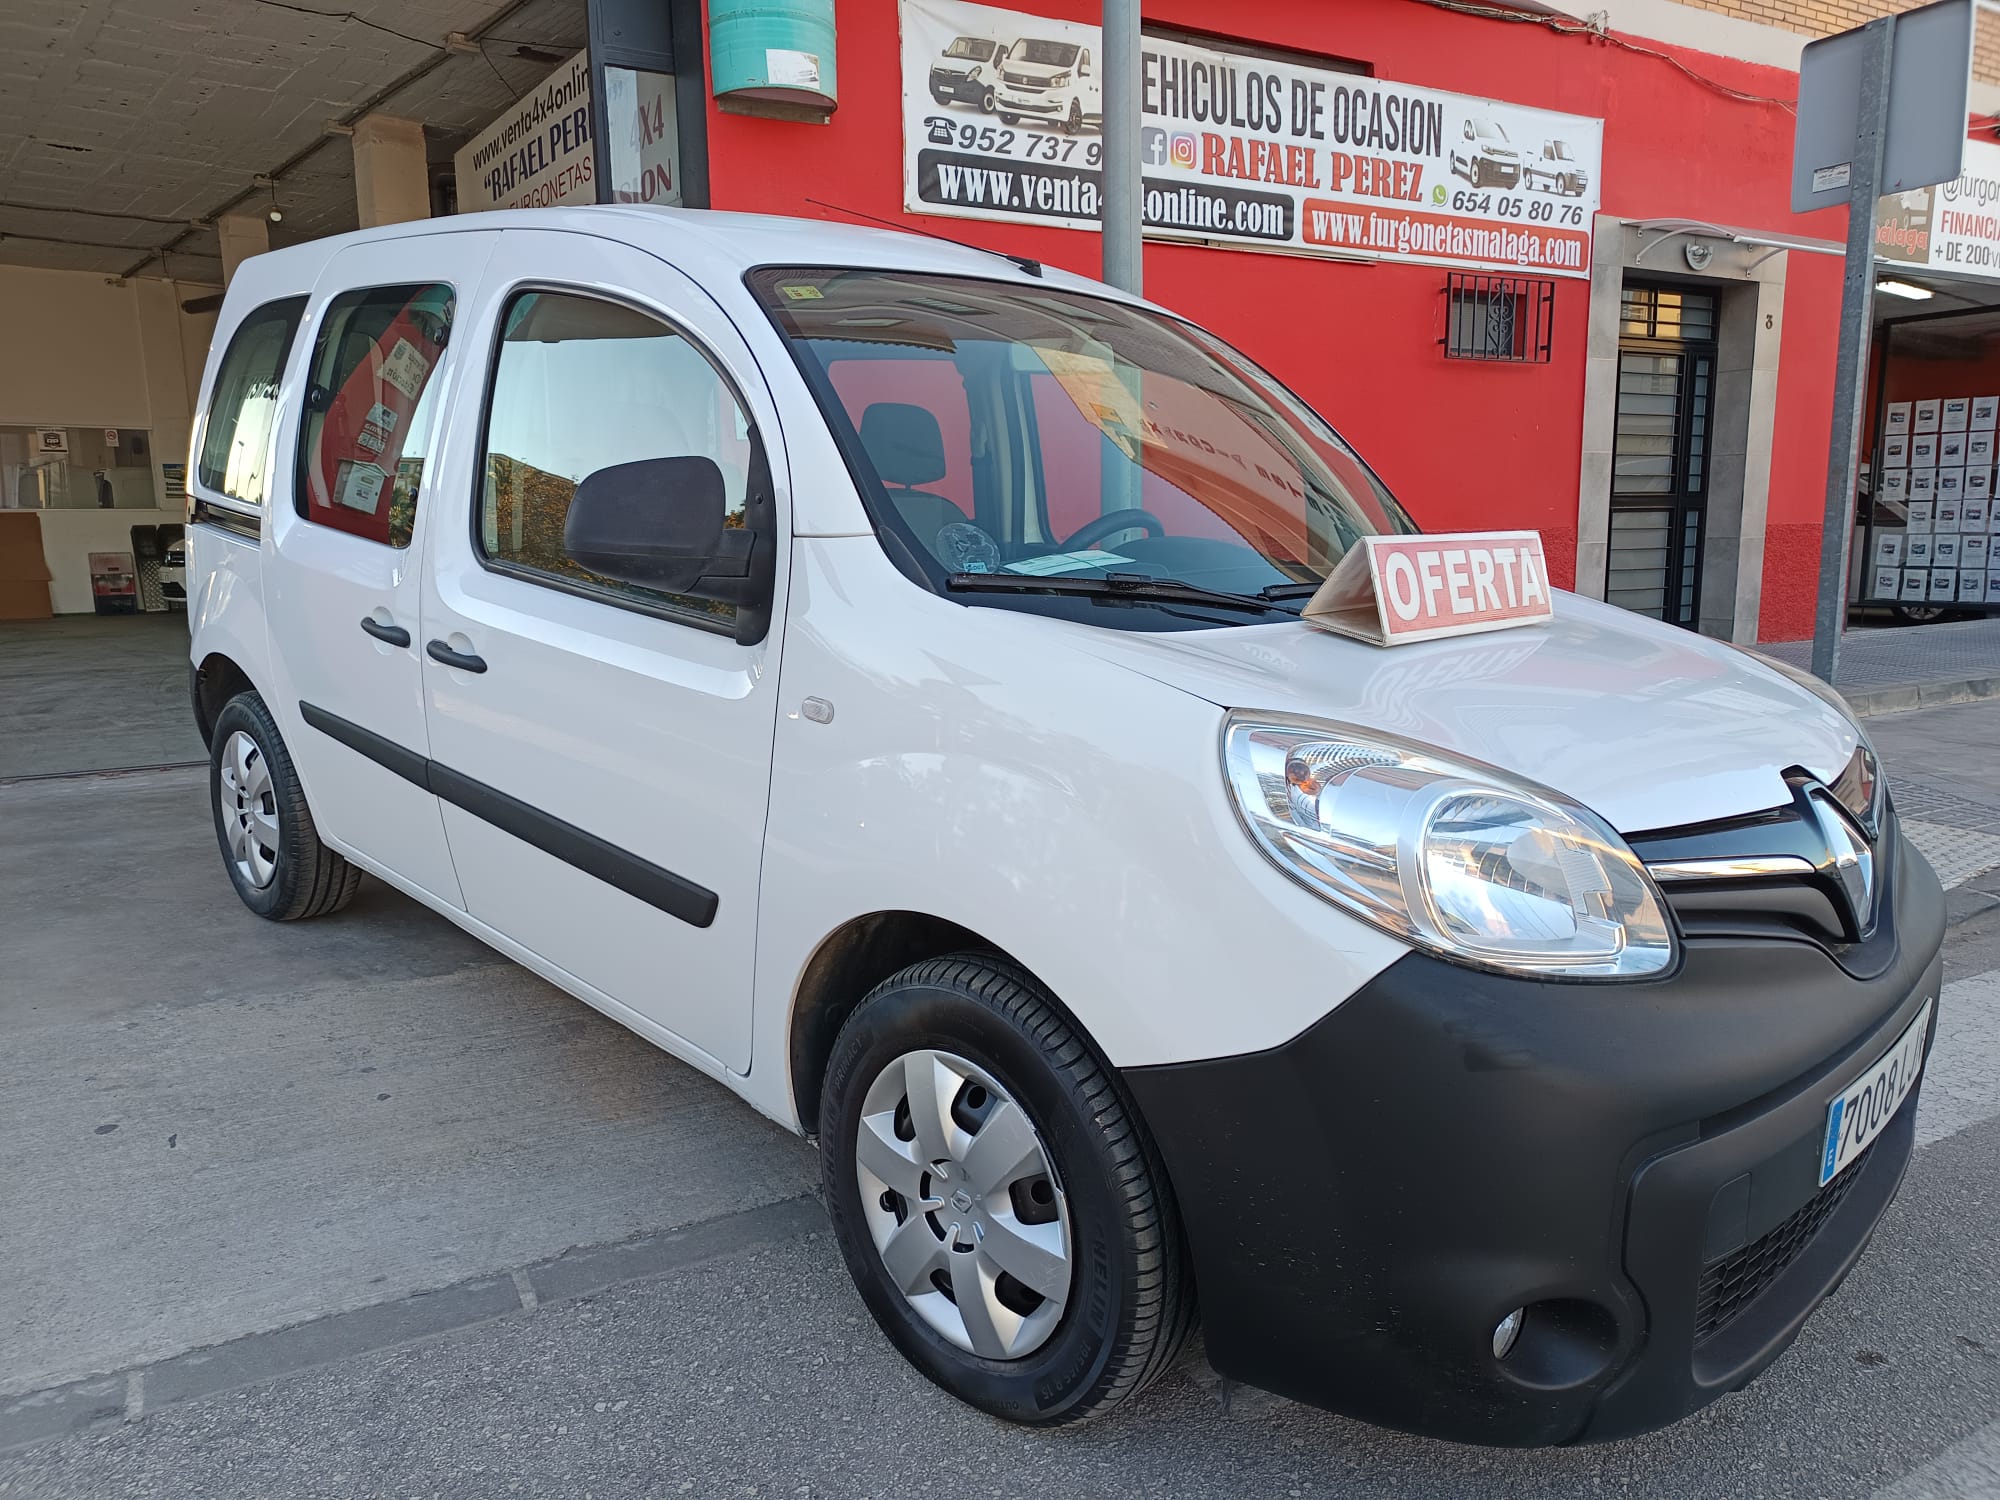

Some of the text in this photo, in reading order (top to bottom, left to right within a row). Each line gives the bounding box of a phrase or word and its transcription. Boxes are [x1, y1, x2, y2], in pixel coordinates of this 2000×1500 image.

[473, 63, 590, 171] www.venta4x4onlin
[1142, 52, 1443, 158] EHICULOS DE OCASION
[958, 124, 1016, 155] 952
[1026, 133, 1079, 162] 737
[1200, 132, 1424, 202] RAFAEL PEREZ
[936, 163, 1284, 236] www.ventaonline.com
[1452, 190, 1583, 225] 654 05 80 76
[1311, 210, 1581, 267] www.furgonetasmalaga.com
[1875, 218, 1929, 255] álaga
[1946, 241, 1963, 262] DE
[1966, 243, 1990, 266] 200
[1765, 314, 1774, 330] 3
[1385, 547, 1546, 622] OFERTA
[1838, 1058, 1899, 1163] 7008
